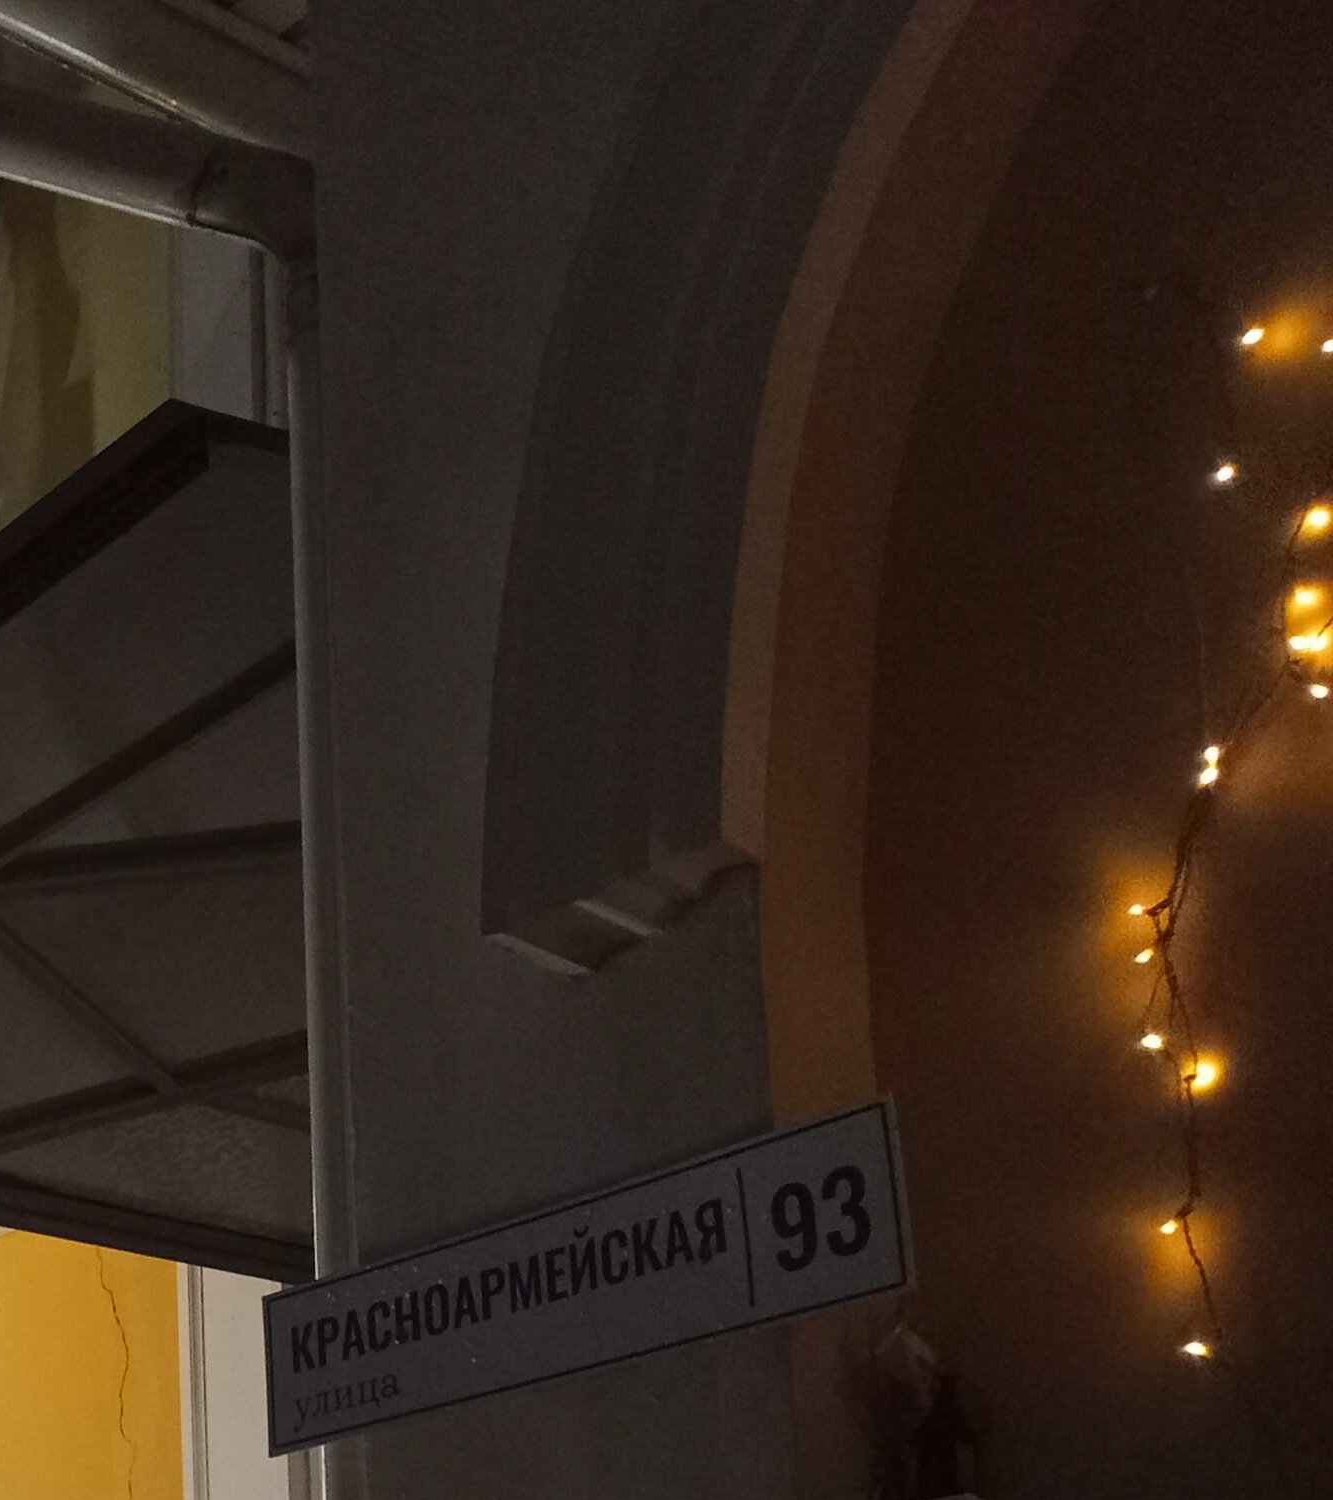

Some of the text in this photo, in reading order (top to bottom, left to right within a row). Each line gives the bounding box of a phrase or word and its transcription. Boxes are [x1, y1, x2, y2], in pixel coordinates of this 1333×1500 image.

[290, 1164, 873, 1373] КРАСНОАРМЕЙСКАЯ 93
[292, 1370, 402, 1433] улица
